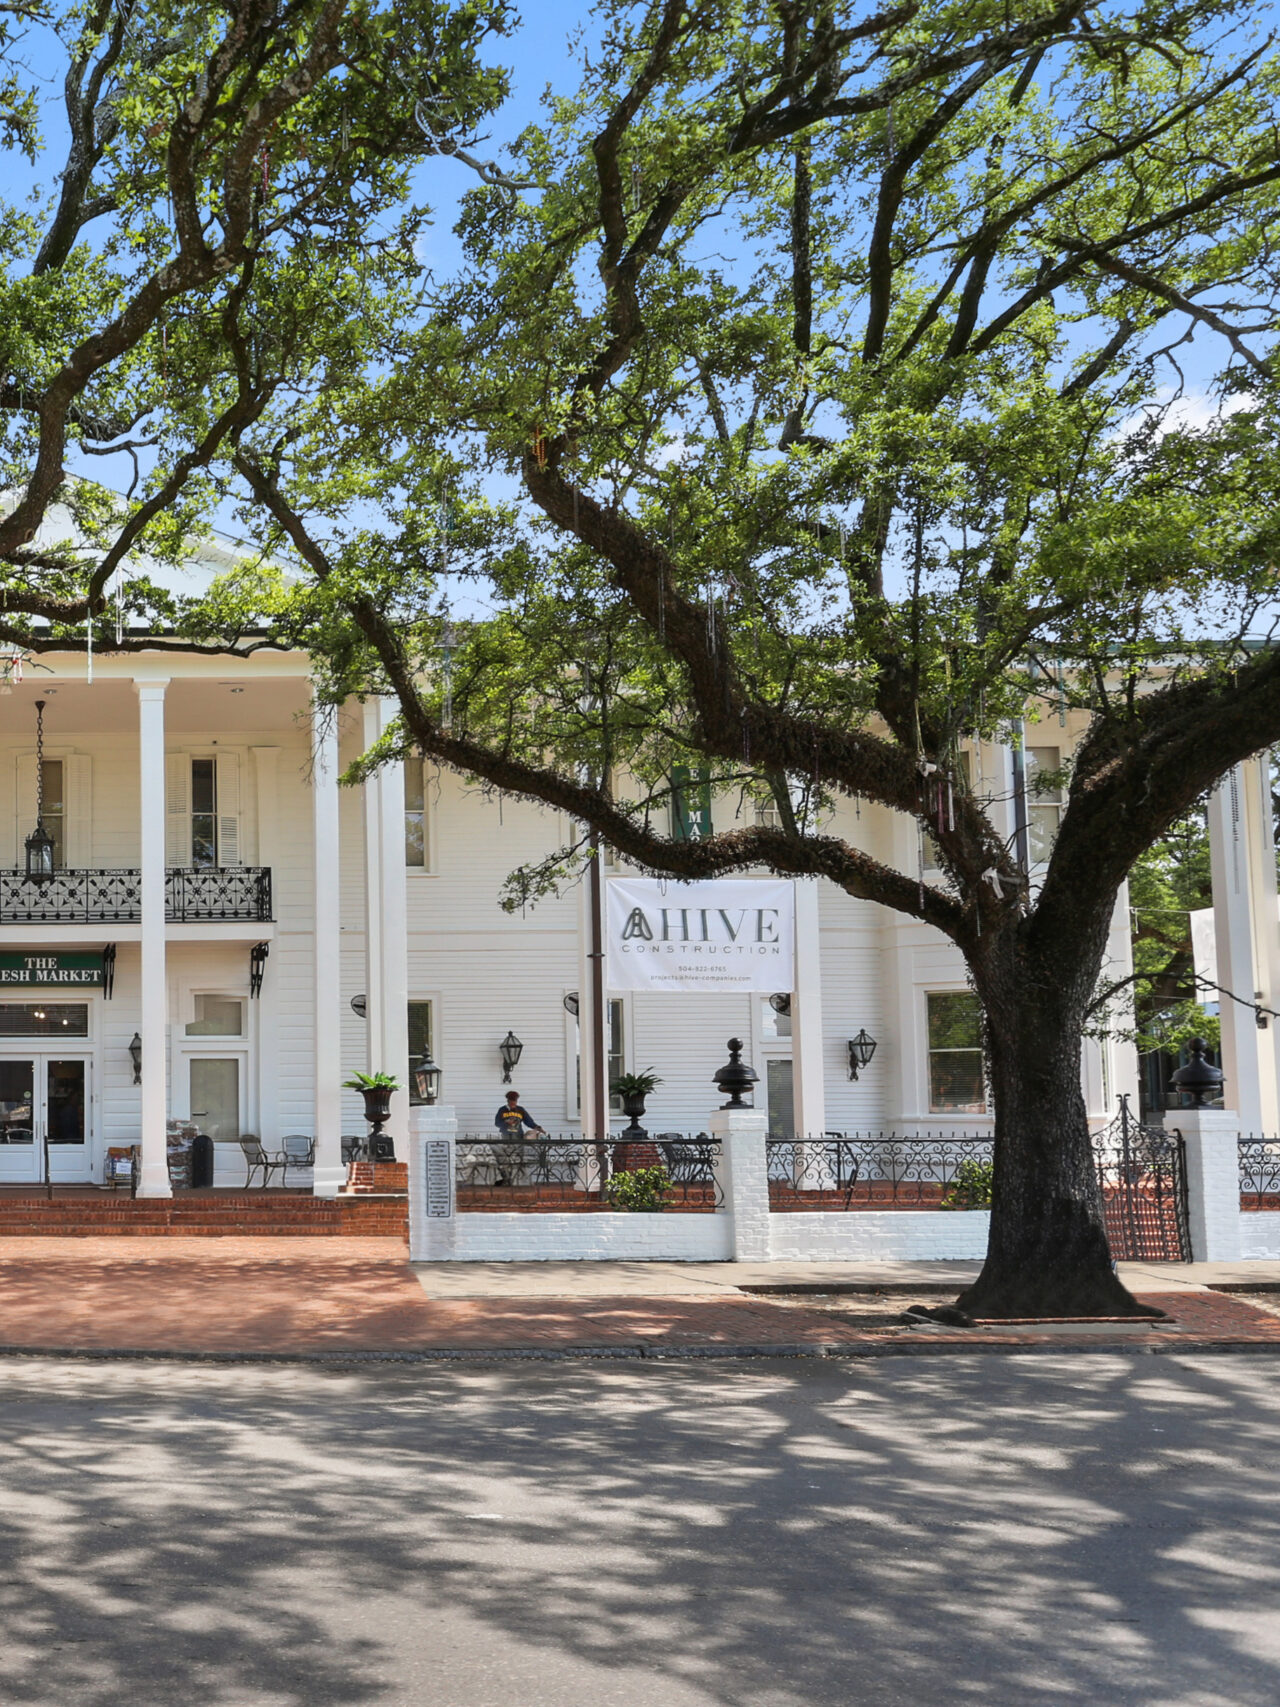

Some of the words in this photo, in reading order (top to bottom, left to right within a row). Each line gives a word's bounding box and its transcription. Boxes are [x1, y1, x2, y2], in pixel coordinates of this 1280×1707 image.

[657, 907, 780, 943] HIVE
[621, 944, 780, 955] CONSTRUCTION
[24, 957, 58, 969] THE
[36, 970, 102, 982] MARKET
